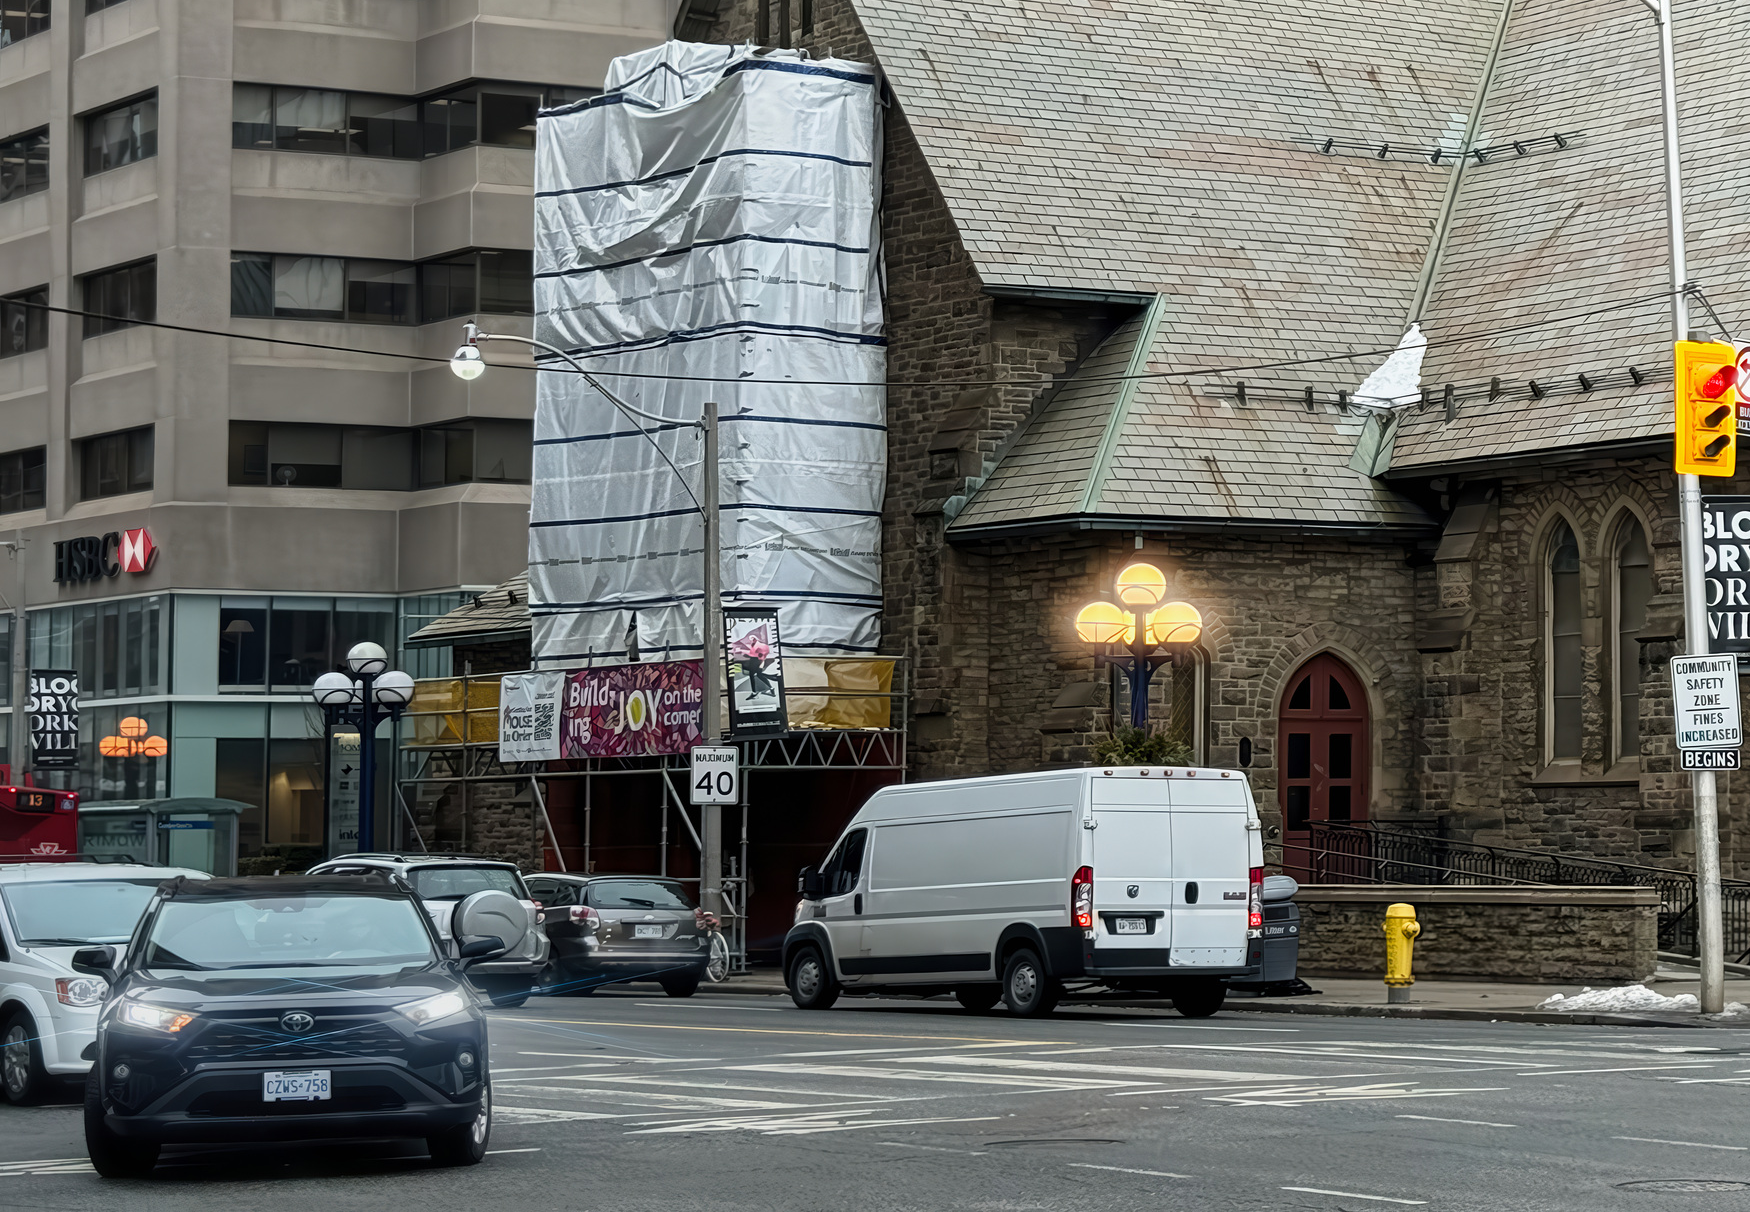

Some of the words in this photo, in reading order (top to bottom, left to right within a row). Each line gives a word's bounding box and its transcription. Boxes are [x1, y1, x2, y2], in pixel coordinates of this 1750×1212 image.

[53, 531, 120, 583] HSBC
[1676, 660, 1732, 675] COMMUNITY
[1686, 677, 1724, 690] SAFETY
[664, 691, 680, 705] on
[682, 684, 702, 703] the
[1693, 694, 1721, 706] ZONE
[614, 688, 663, 735] JOY
[663, 709, 702, 726] corner
[1693, 713, 1724, 725] FINES
[1681, 728, 1738, 742] INCREASED
[695, 754, 734, 762] MAXIMUM
[1685, 751, 1735, 767] BEGINS
[694, 771, 734, 796] 40
[29, 794, 43, 806] 13
[266, 1080, 299, 1094] CZWS
[304, 1078, 328, 1093] 758
